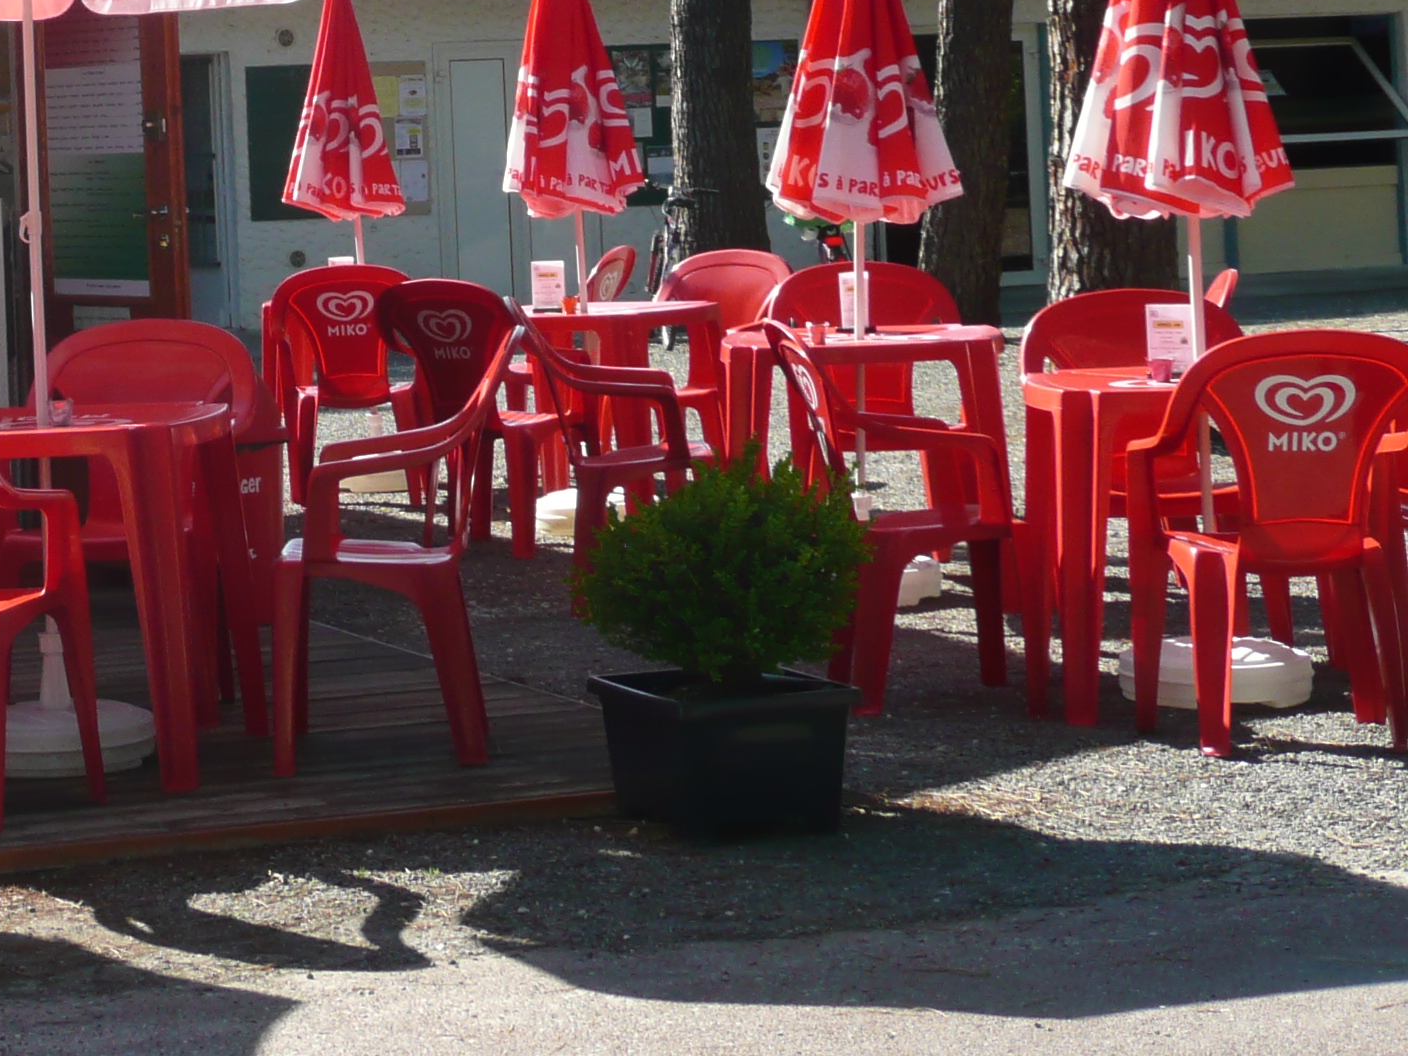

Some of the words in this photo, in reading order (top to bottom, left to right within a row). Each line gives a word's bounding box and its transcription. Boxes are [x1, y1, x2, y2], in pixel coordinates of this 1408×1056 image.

[327, 323, 367, 336] MIKO
[433, 346, 471, 360] MIKO
[1268, 431, 1338, 452] MIKO
